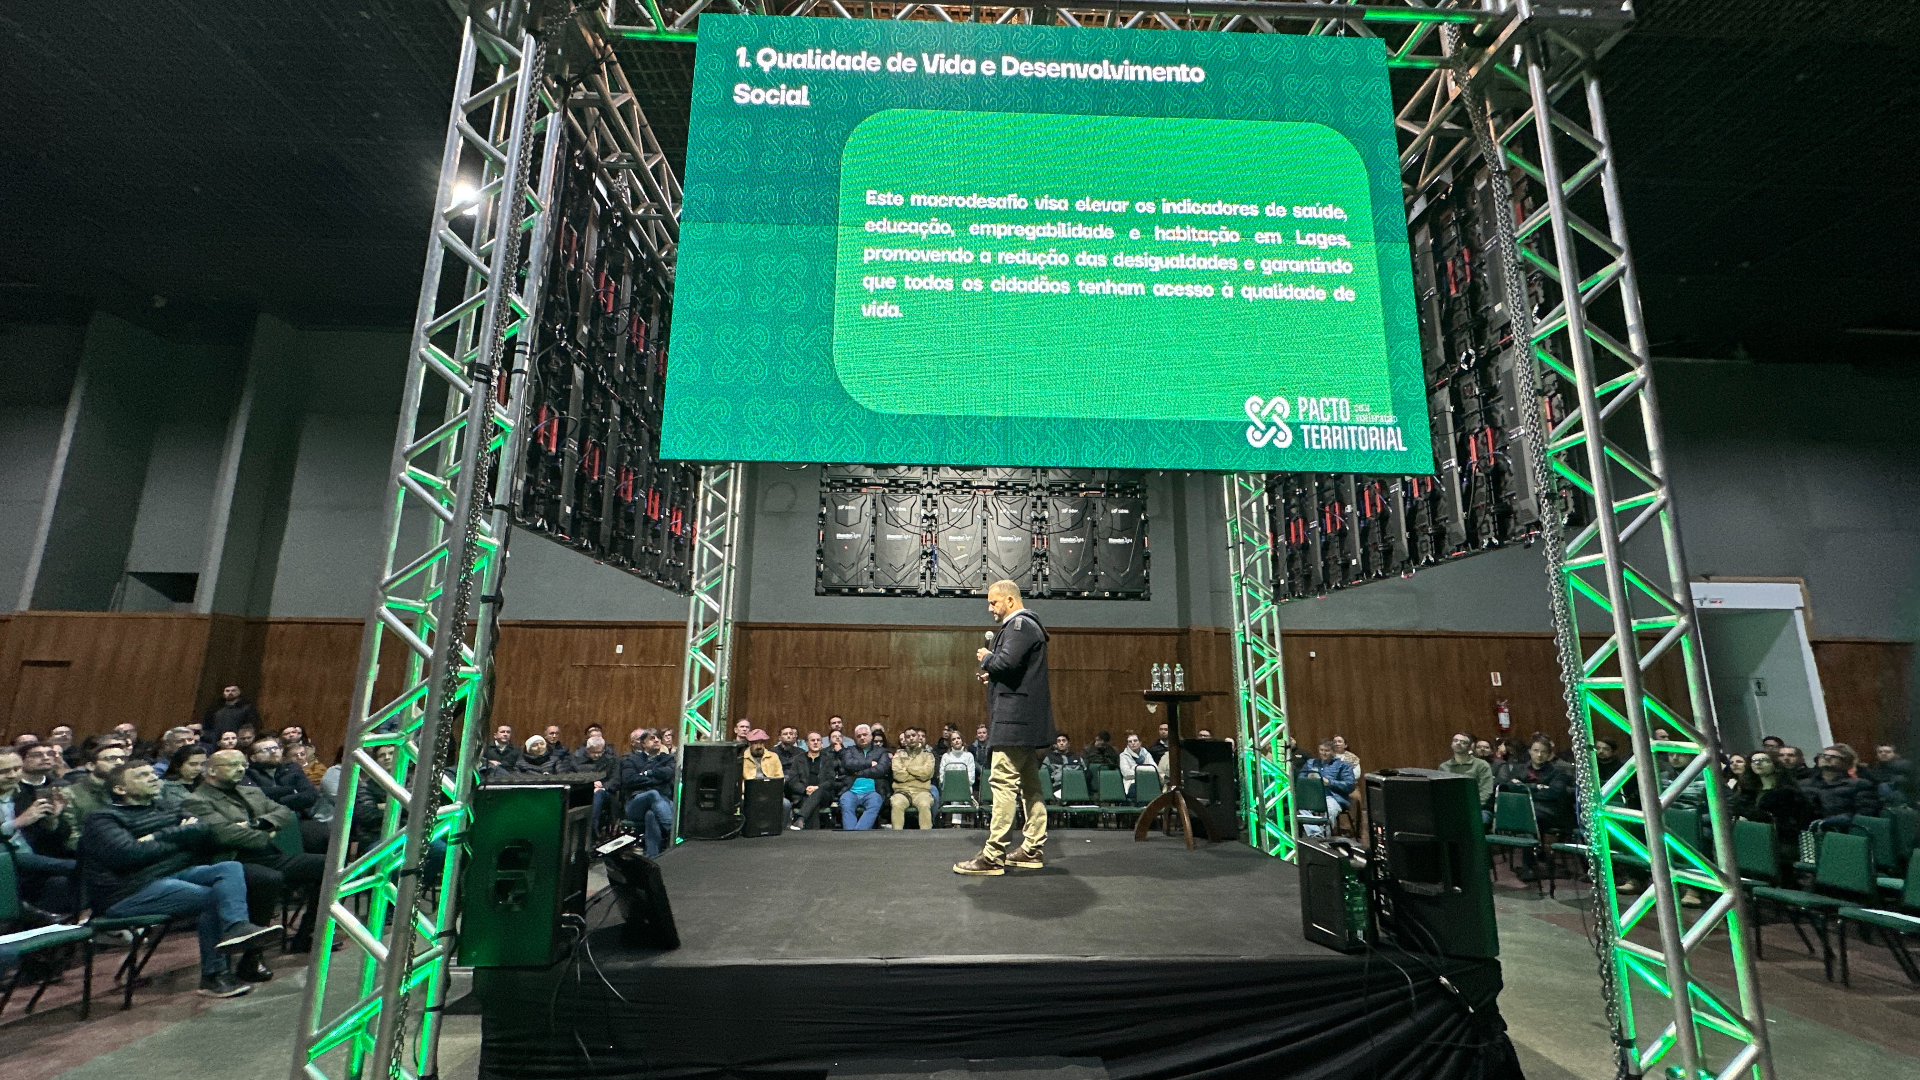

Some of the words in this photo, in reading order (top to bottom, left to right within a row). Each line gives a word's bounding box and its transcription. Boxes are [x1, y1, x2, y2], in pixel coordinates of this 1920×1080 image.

[737, 47, 751, 67] 1.
[757, 48, 881, 72] Qualidade
[886, 52, 917, 72] de
[922, 53, 976, 74] Vida
[981, 60, 996, 75] e
[1002, 56, 1205, 82] Desenvolvimento
[733, 84, 809, 105] Social
[866, 190, 904, 206] Este
[910, 193, 1028, 209] macrodesafio
[1035, 195, 1068, 210] visa
[1075, 197, 1129, 212] elevar
[1135, 202, 1156, 213] os
[1162, 198, 1259, 216] indicadores
[1265, 202, 1286, 217] de
[1293, 203, 1347, 221] saúde,
[865, 218, 954, 239] educação,
[969, 222, 1114, 240] empregabilidade
[1130, 229, 1140, 239] e
[1155, 225, 1240, 246] habitação
[1255, 232, 1282, 244] em
[1296, 230, 1350, 249] Lages,
[863, 247, 974, 263] promovendo
[980, 251, 991, 263] a
[998, 248, 1069, 269] redução
[1075, 251, 1107, 267] das
[1113, 252, 1237, 271] desigualdades
[1244, 259, 1255, 270] e
[1261, 257, 1353, 275] garantindo
[863, 276, 896, 292] que
[904, 275, 953, 291] todos
[962, 278, 983, 291] os
[990, 275, 1070, 293] cidadãos
[1078, 279, 1145, 295] tenham
[1153, 284, 1214, 297] acesso
[1222, 281, 1233, 298] à
[1241, 283, 1326, 301] qualidade
[1333, 286, 1355, 301] de
[862, 301, 903, 317] vida.
[1297, 397, 1350, 422] PACTO
[1300, 424, 1407, 451] TERRITORIAL
